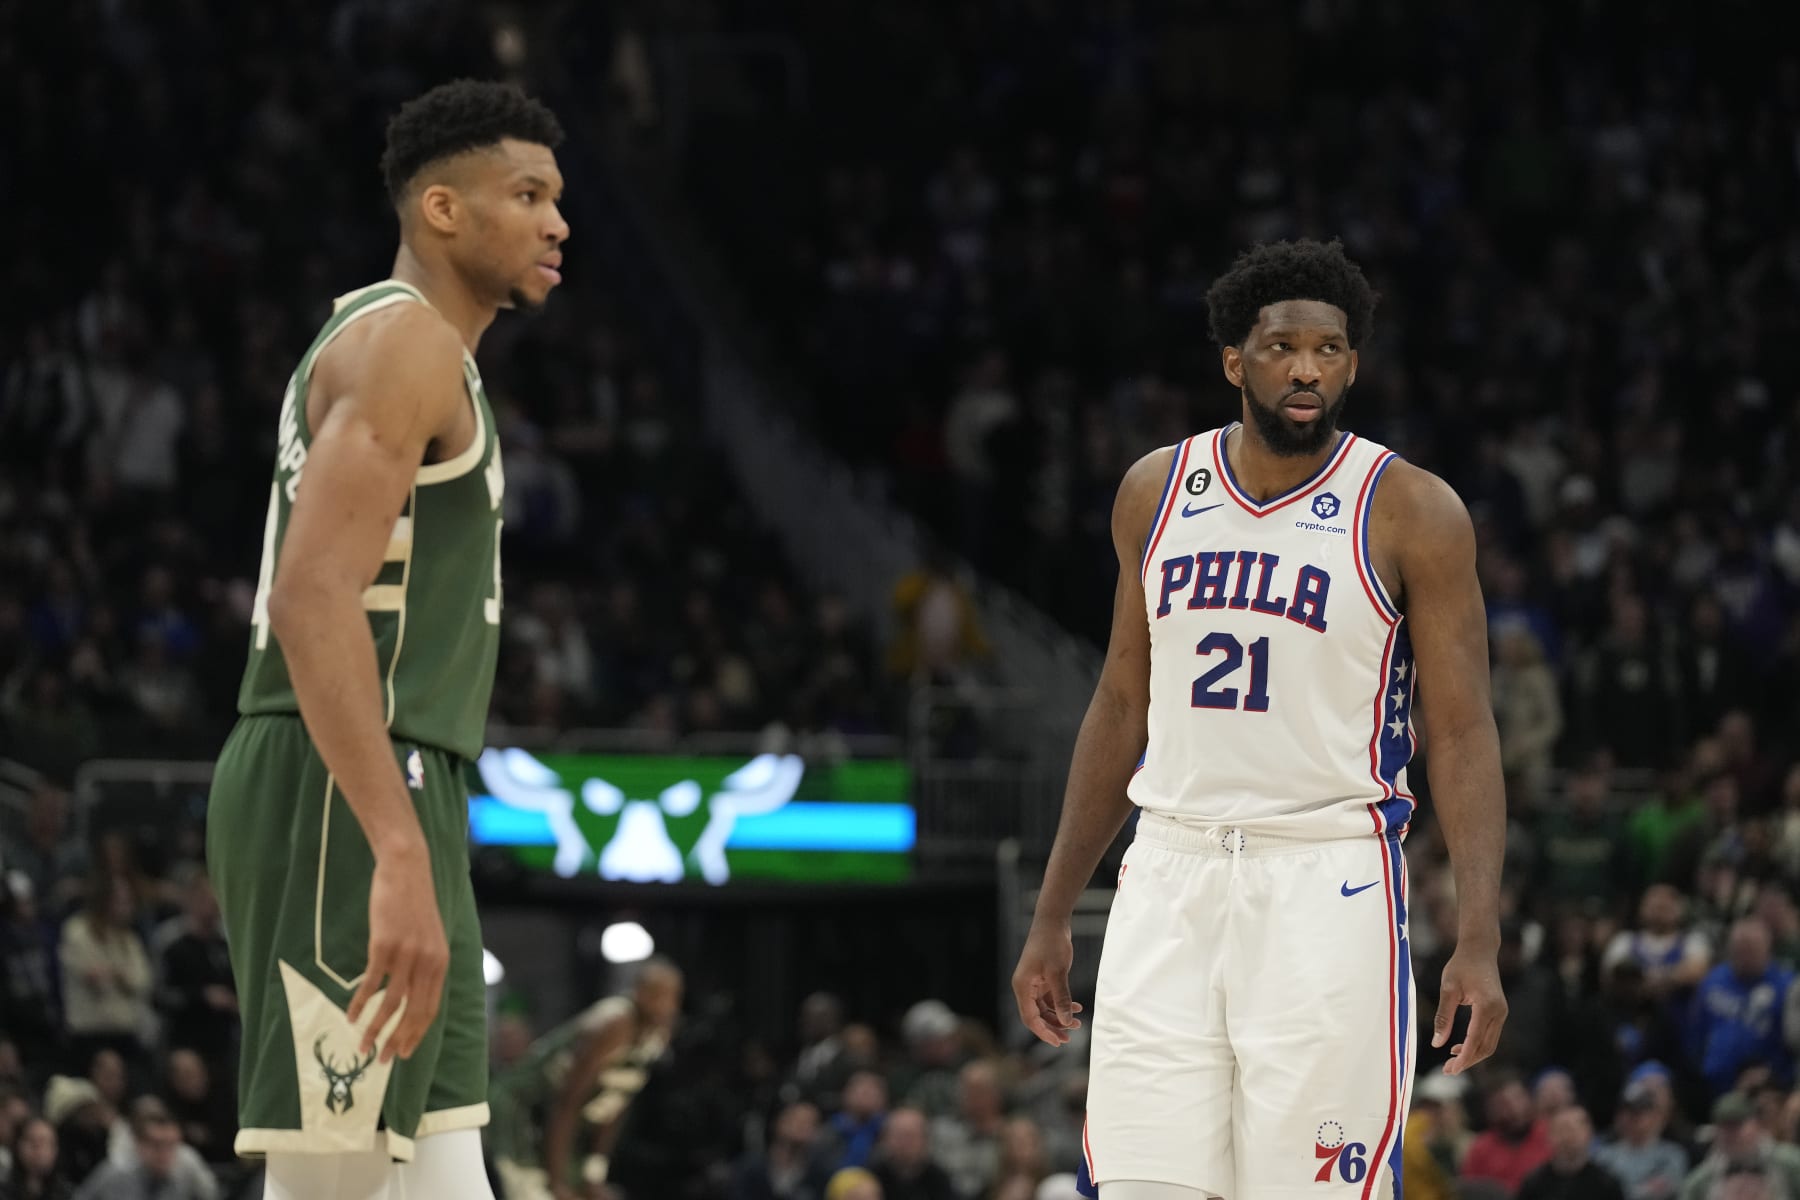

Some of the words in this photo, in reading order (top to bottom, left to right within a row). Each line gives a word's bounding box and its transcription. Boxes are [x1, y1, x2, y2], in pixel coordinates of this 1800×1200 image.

[1191, 472, 1207, 493] 6
[1295, 521, 1346, 535] crypto.com
[1156, 550, 1331, 634] PHILA
[1190, 632, 1270, 713] 21
[1314, 1141, 1367, 1184] 76
